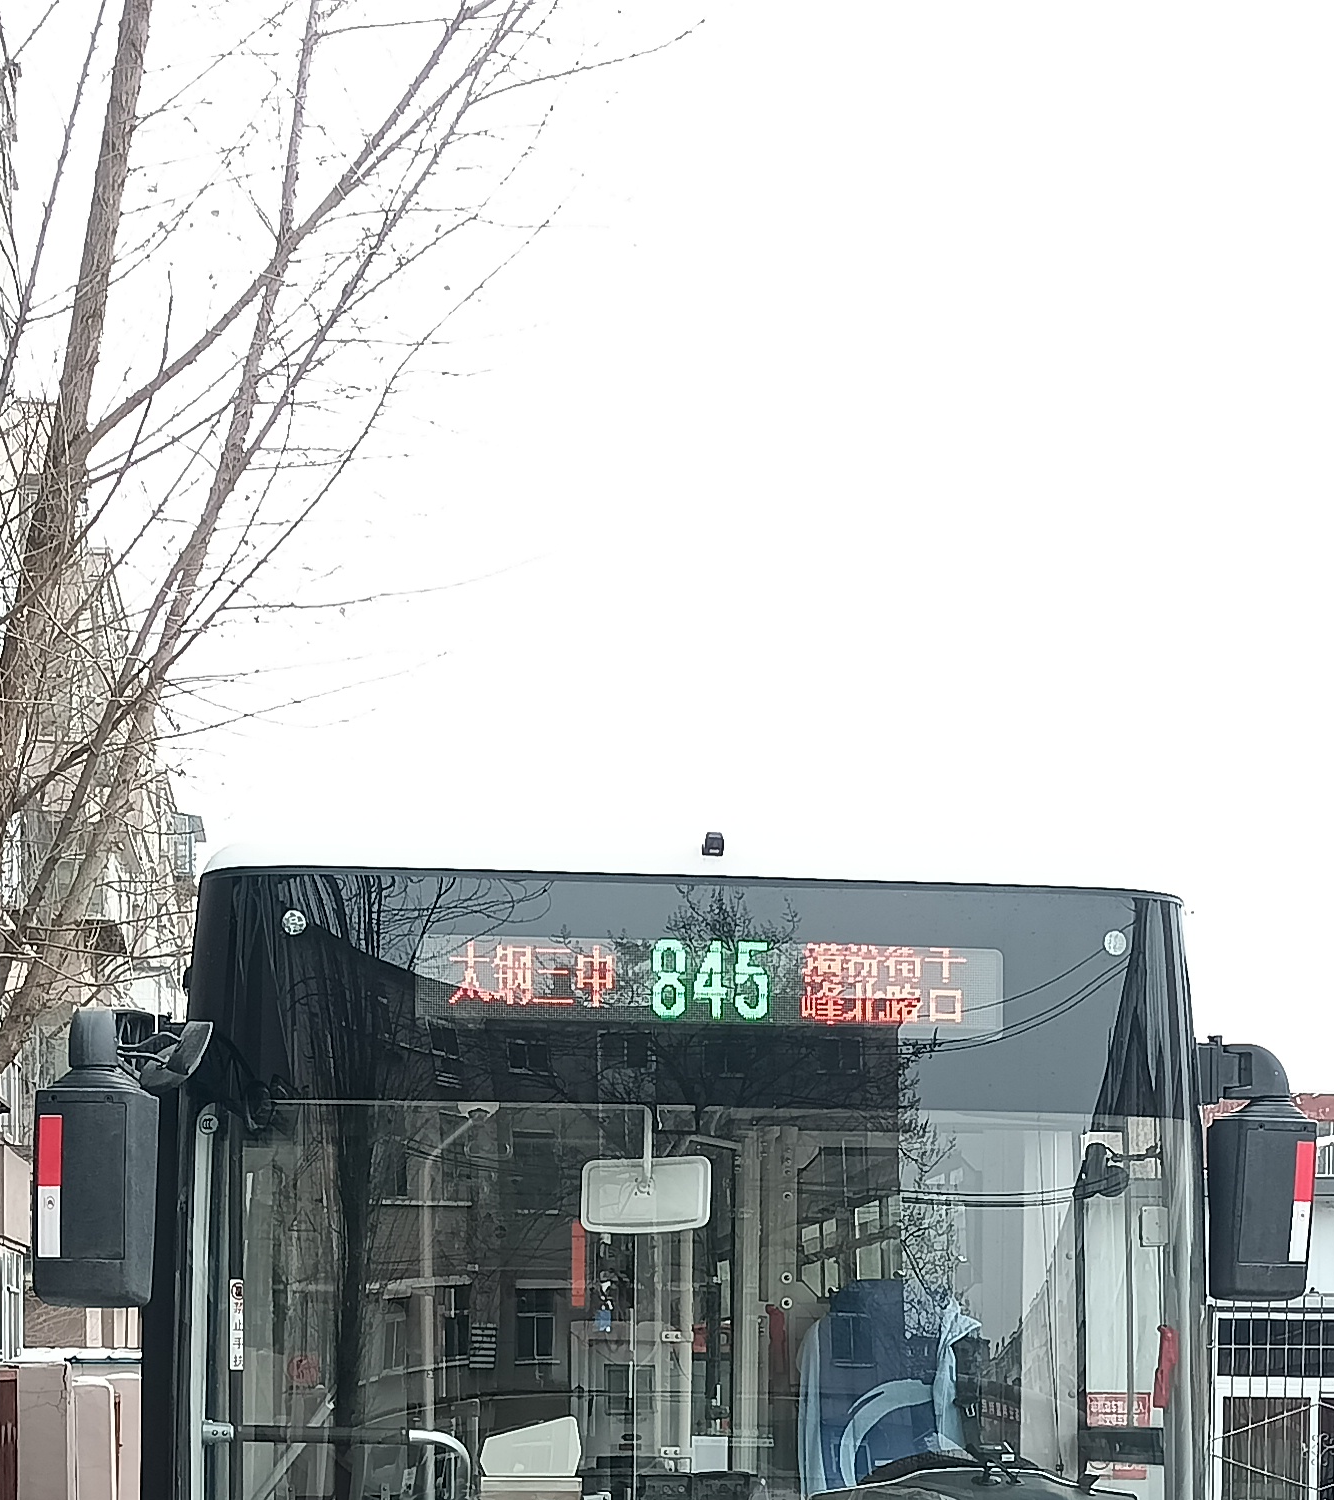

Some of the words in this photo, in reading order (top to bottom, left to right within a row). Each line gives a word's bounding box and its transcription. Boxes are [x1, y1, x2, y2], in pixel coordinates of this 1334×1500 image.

[448, 940, 616, 1008] 太钢三中
[652, 938, 770, 1020] 845
[801, 981, 963, 1025] 峰北路口
